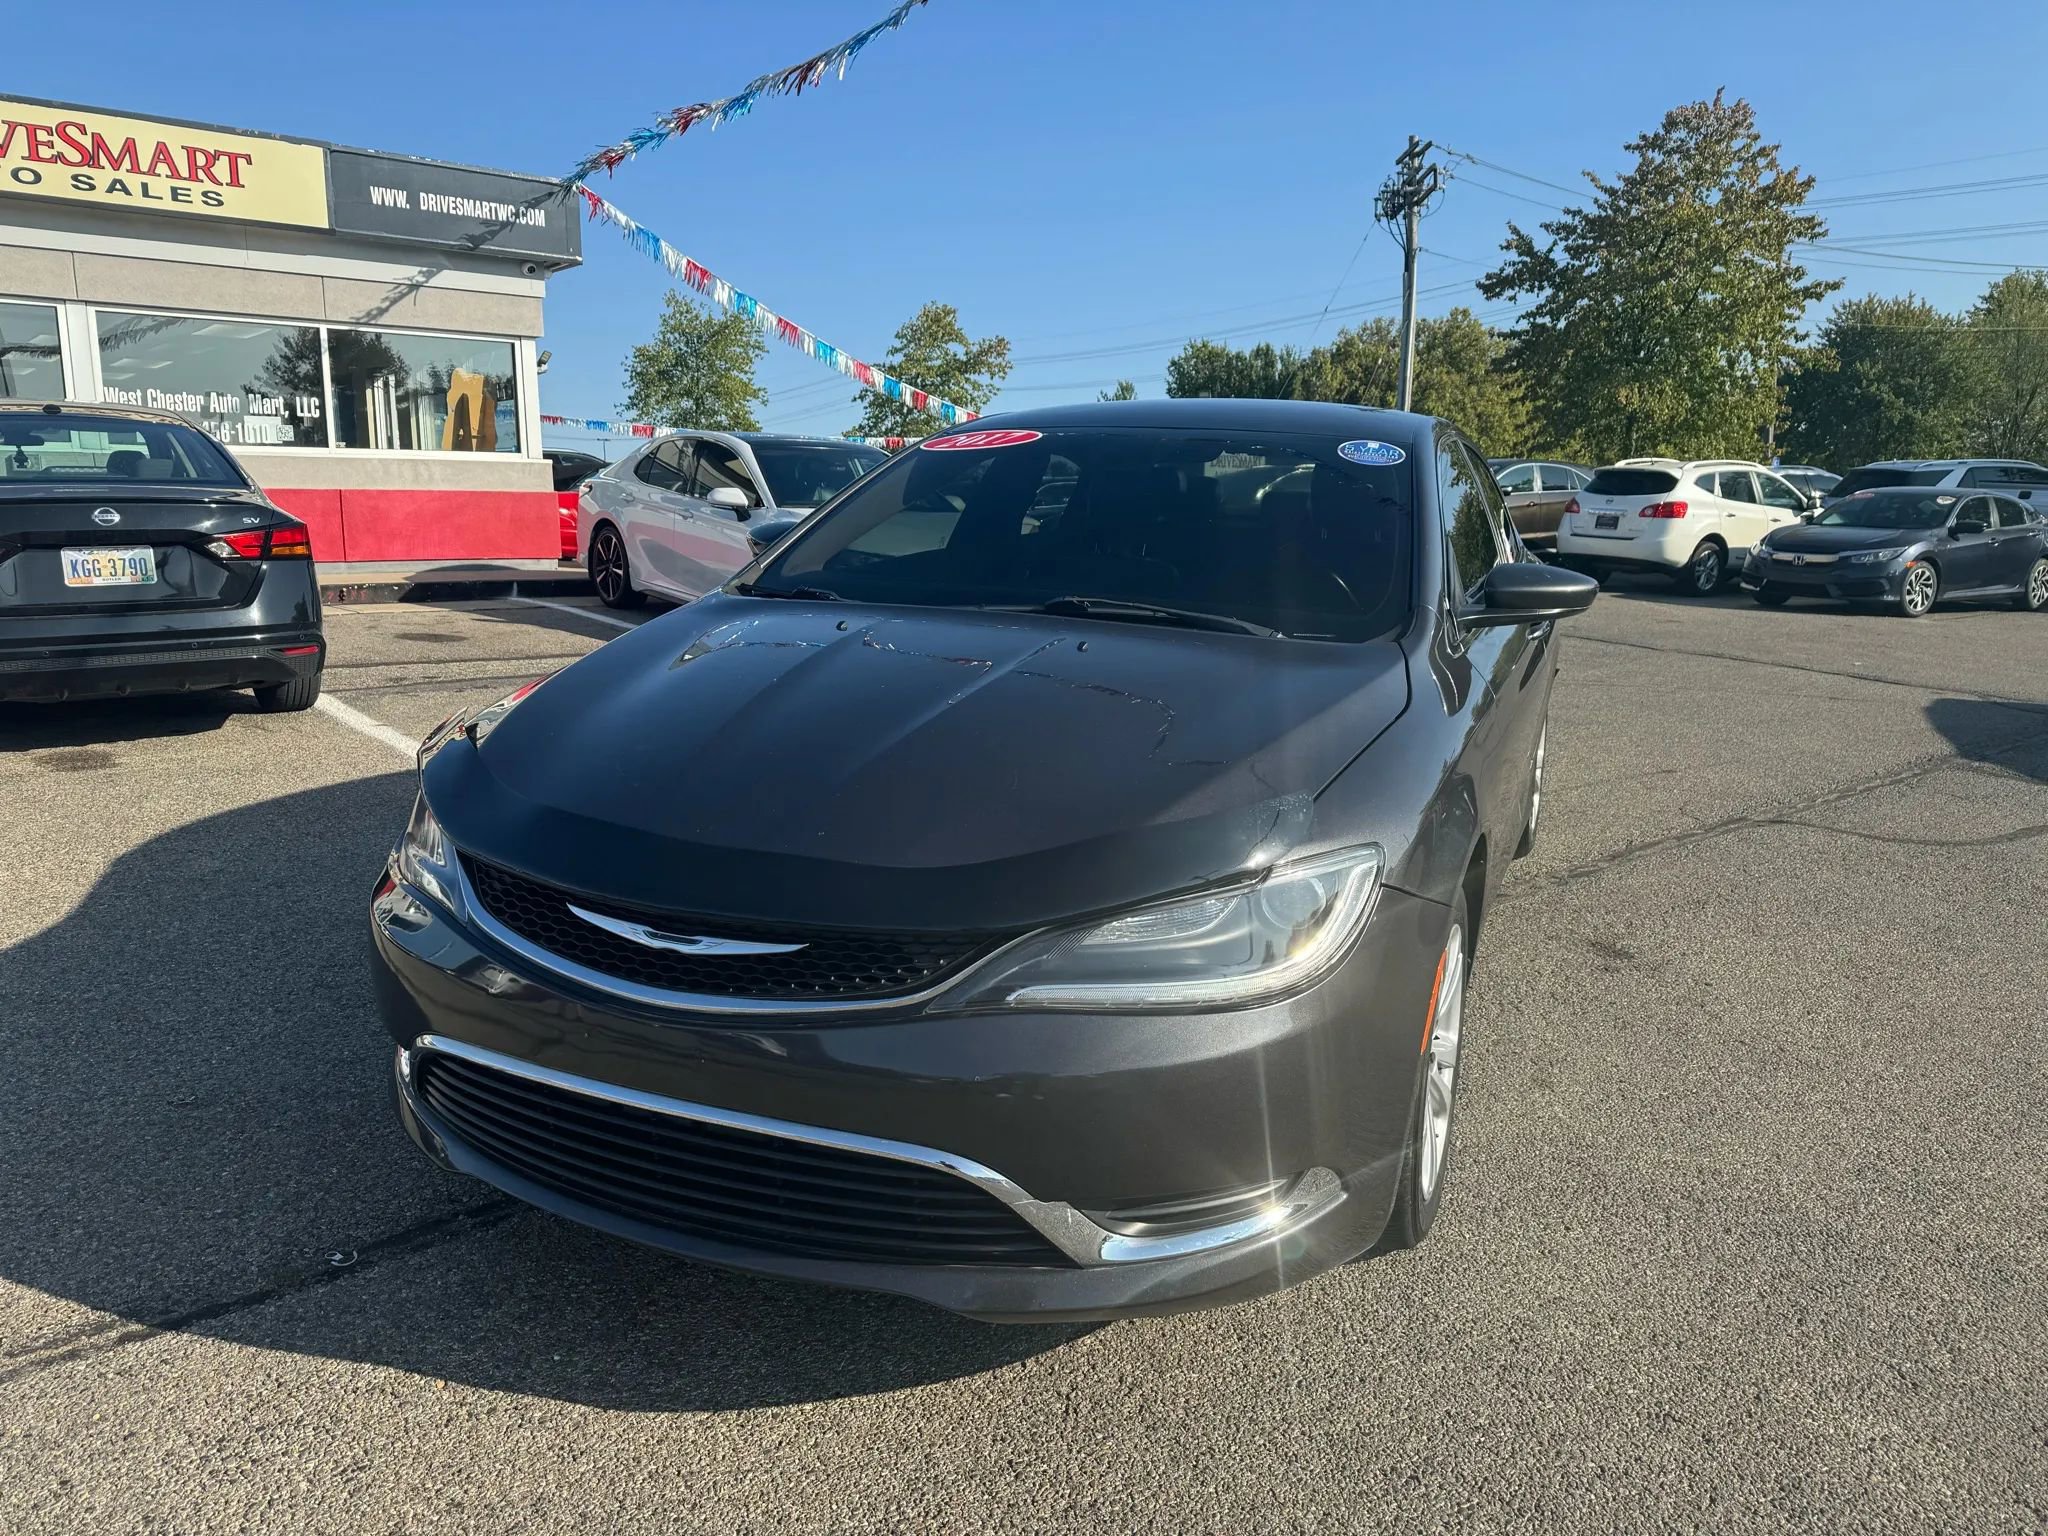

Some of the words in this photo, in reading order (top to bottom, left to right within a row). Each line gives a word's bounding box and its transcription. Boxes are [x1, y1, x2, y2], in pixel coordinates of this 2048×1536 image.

[0, 166, 43, 185] O
[70, 173, 225, 207] SALES
[370, 186, 410, 209] WWW.
[419, 192, 546, 227] DRIVESMARTWC.COM
[104, 387, 142, 406] West
[147, 388, 204, 412] Chester
[210, 391, 240, 414] Auto
[249, 394, 289, 419] Mart,
[296, 396, 320, 418] LLC
[70, 558, 102, 577] KGG
[108, 557, 148, 577] 3790
